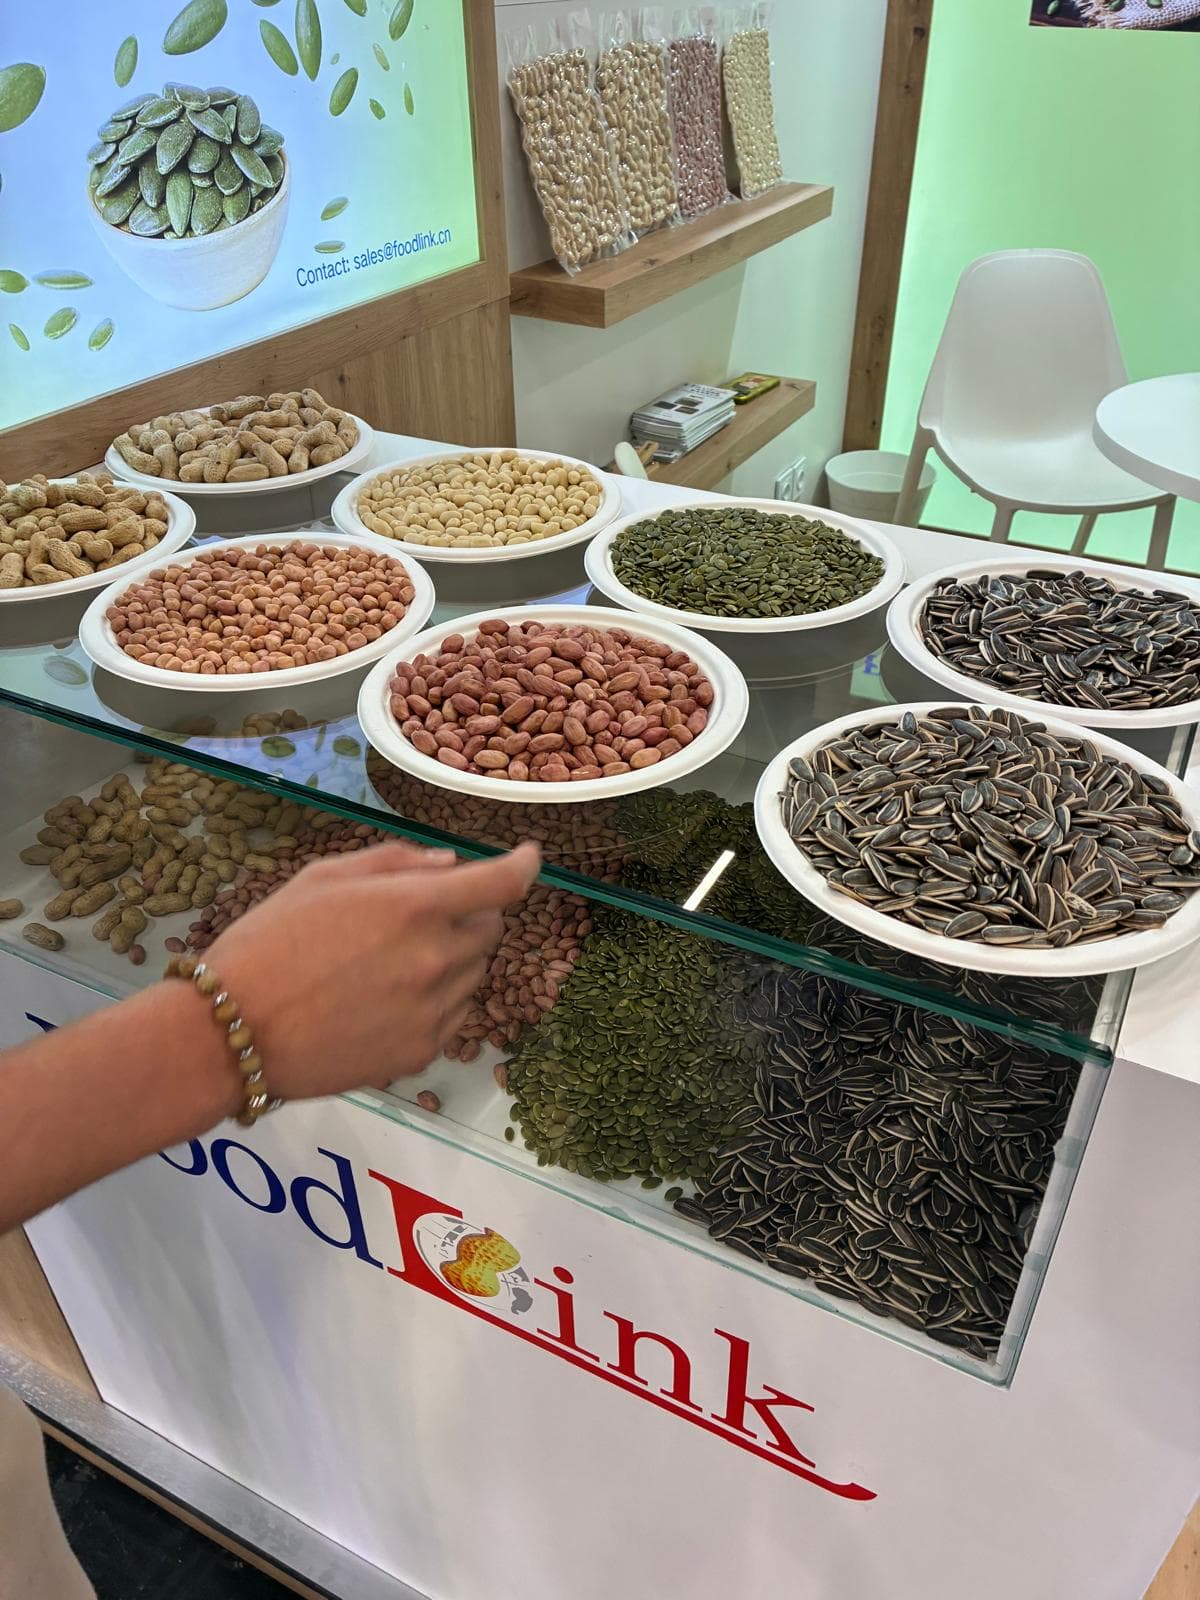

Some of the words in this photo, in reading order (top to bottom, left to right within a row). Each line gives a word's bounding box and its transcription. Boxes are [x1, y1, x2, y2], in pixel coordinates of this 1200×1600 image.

[296, 257, 350, 287] Contact:
[353, 228, 452, 270] sales@foodlink.cn
[25, 1011, 877, 1501] odLink
